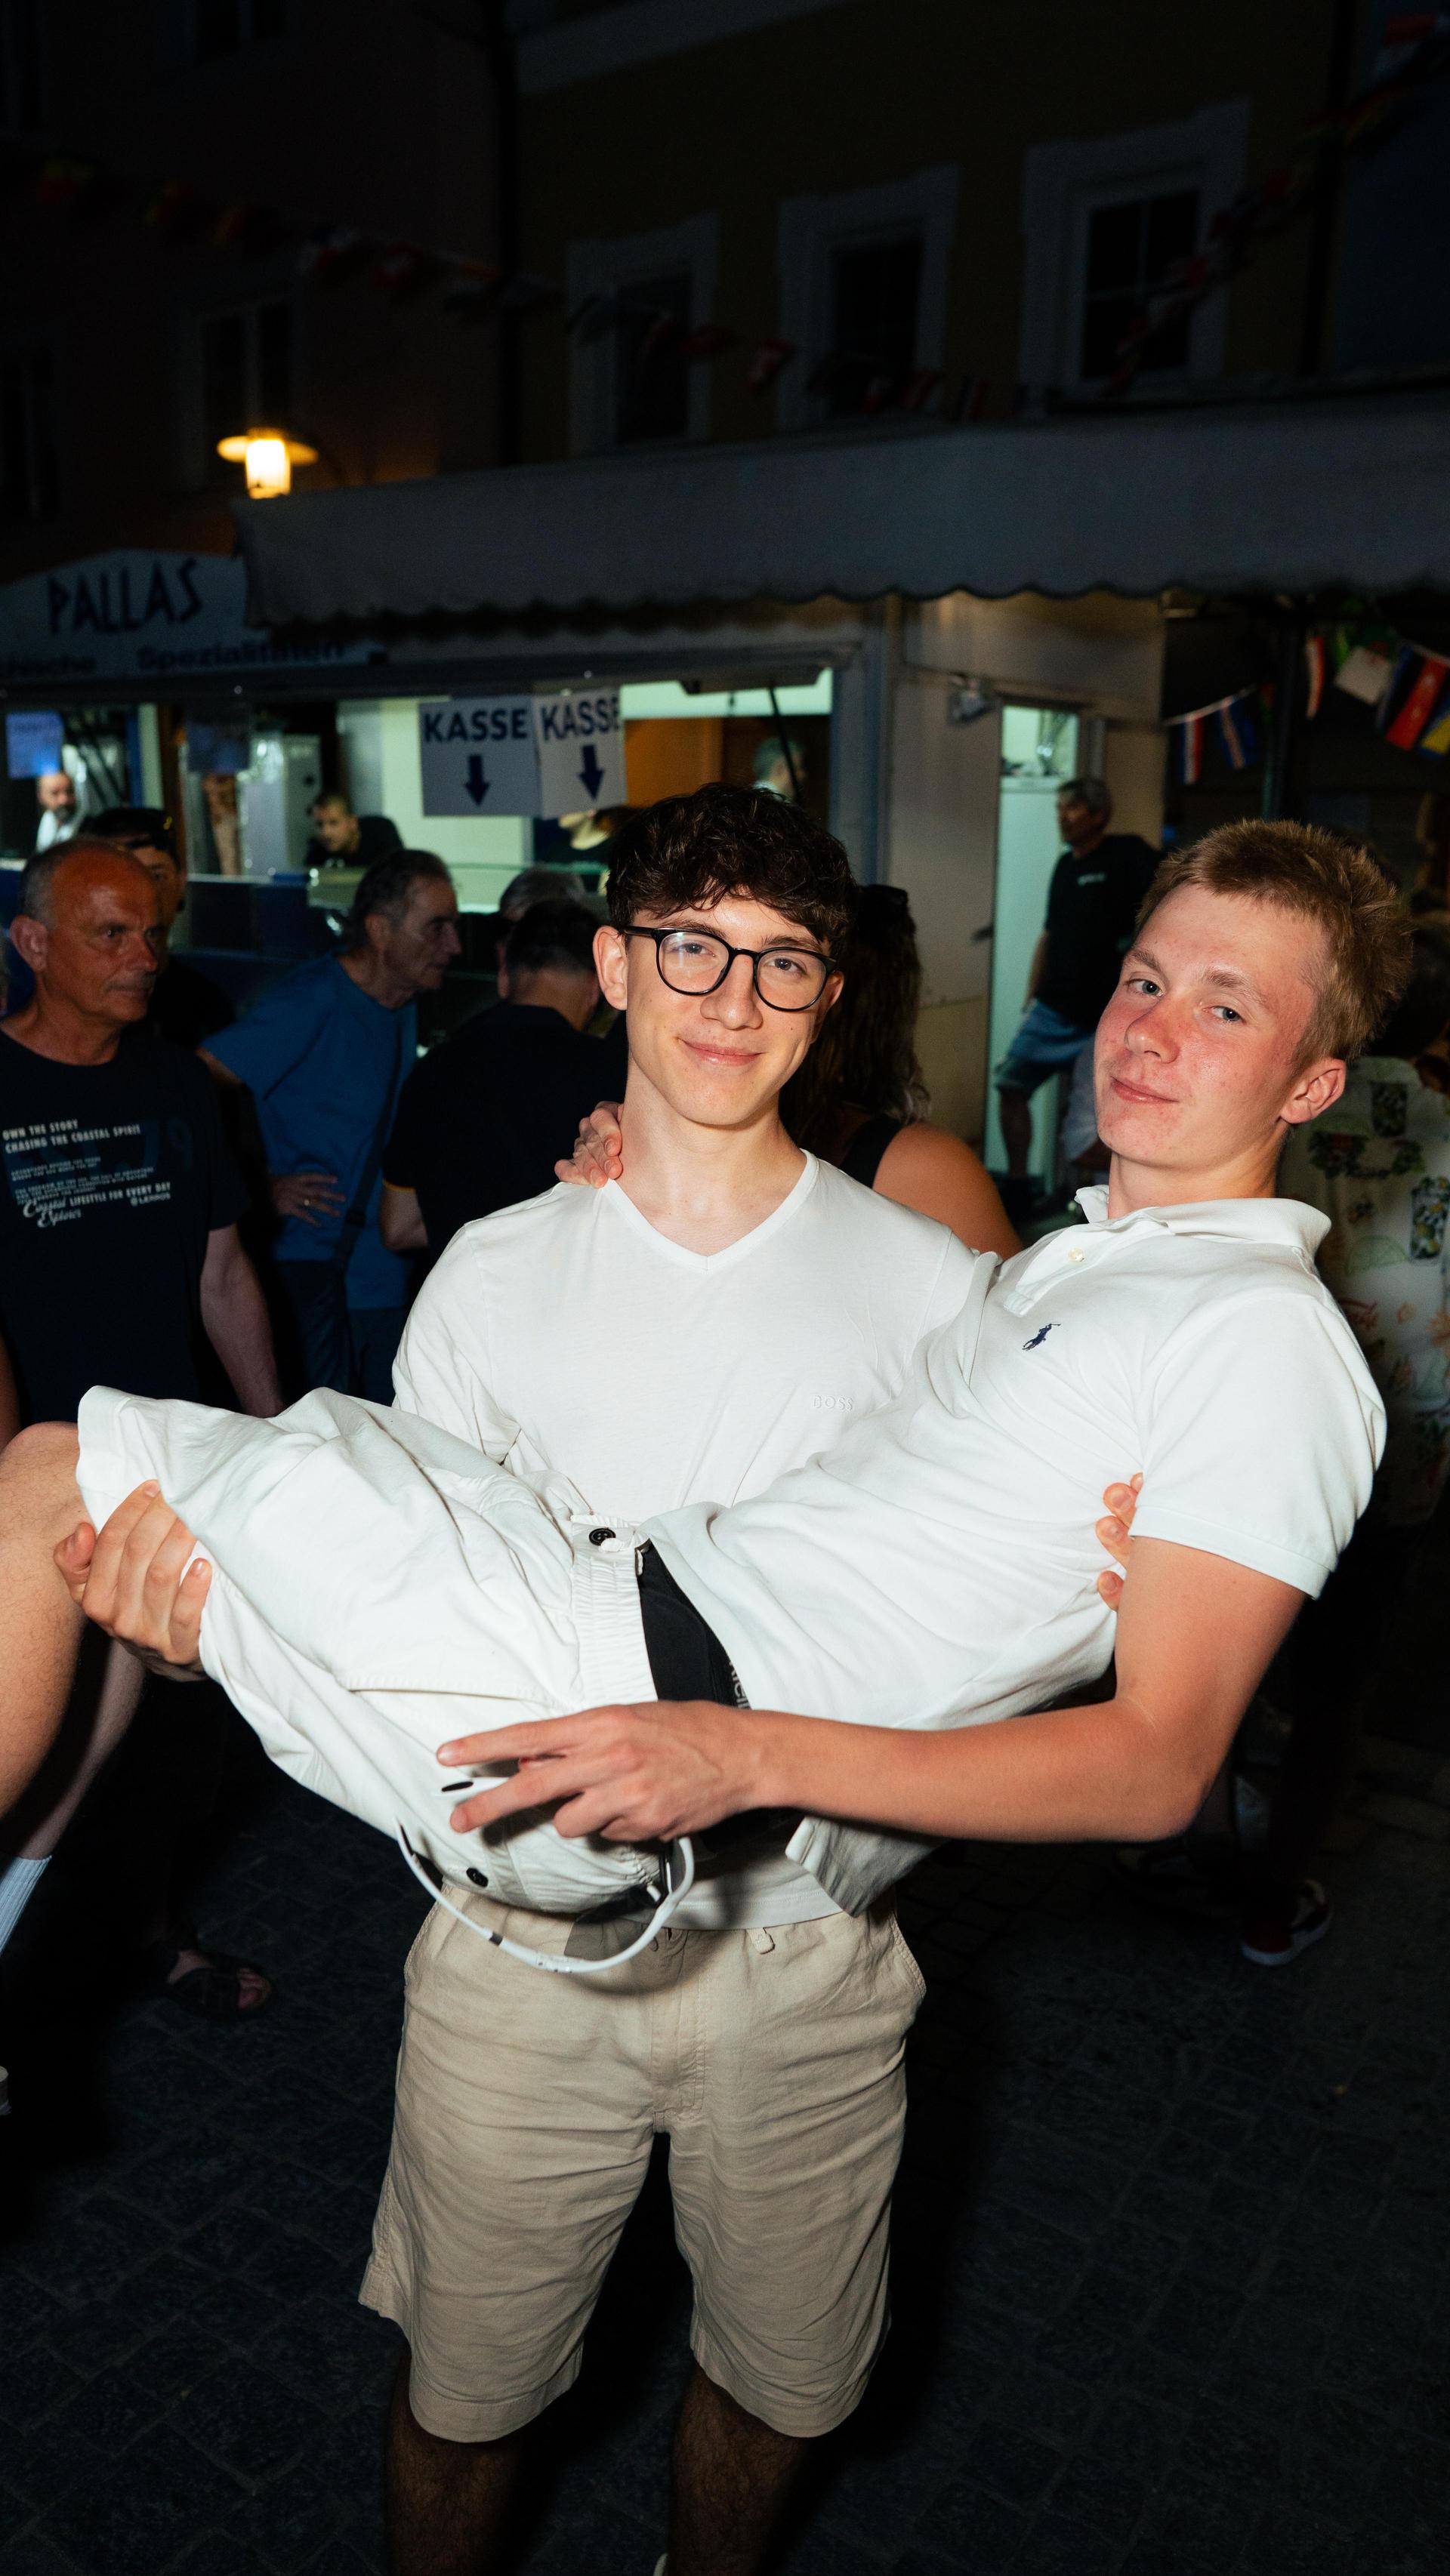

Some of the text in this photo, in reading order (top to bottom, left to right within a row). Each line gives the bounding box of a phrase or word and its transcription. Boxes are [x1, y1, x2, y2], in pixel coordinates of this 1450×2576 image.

[48, 558, 202, 634] PALLAS
[424, 709, 527, 741] KASSE
[5, 1123, 141, 1154] CHASING THE COASTAL SPIRIT
[29, 1123, 47, 1135] THE
[49, 1118, 78, 1132] STORY
[69, 1191, 107, 1206] LIFESTYLE
[109, 1189, 124, 1200] FOR
[125, 1184, 152, 1197] EVERY
[155, 1181, 171, 1192] DAY
[813, 1394, 853, 1412] BOSS
